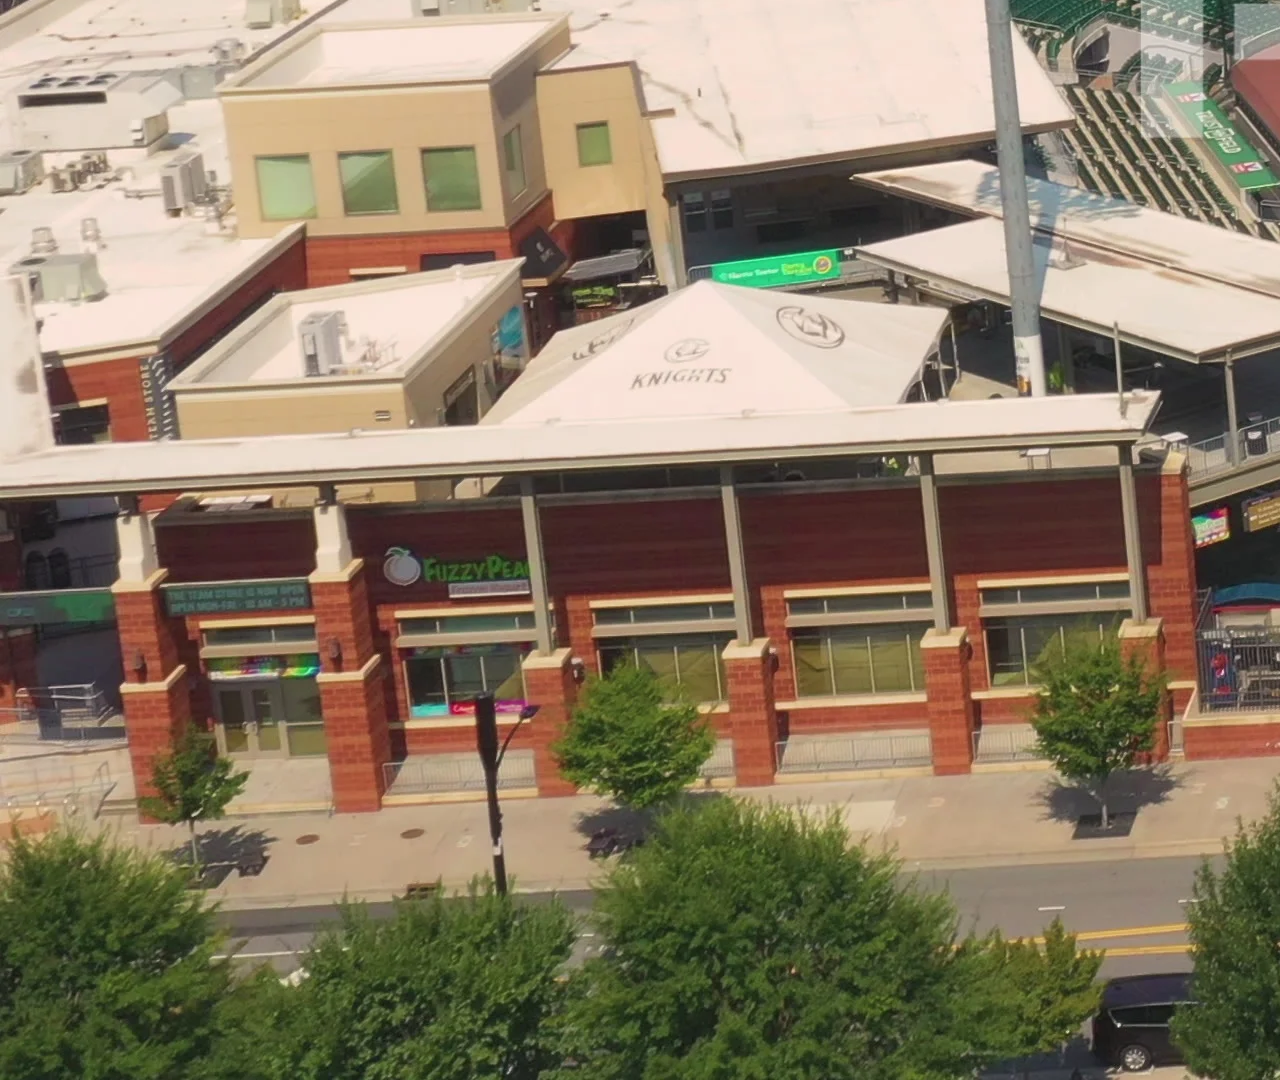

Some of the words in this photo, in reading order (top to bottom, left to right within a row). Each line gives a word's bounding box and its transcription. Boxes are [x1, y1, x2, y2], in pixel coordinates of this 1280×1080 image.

[140, 364, 154, 403] STORE
[630, 367, 732, 390] KNIGHTS
[145, 406, 159, 439] TEAM
[168, 591, 184, 601] THE
[187, 590, 213, 601] TEAM
[214, 588, 246, 599] STORE
[257, 586, 278, 596] NOW
[279, 584, 305, 595] OPEN
[171, 601, 195, 613] OPEN
[257, 598, 274, 608] AM
[288, 596, 305, 607] PM
